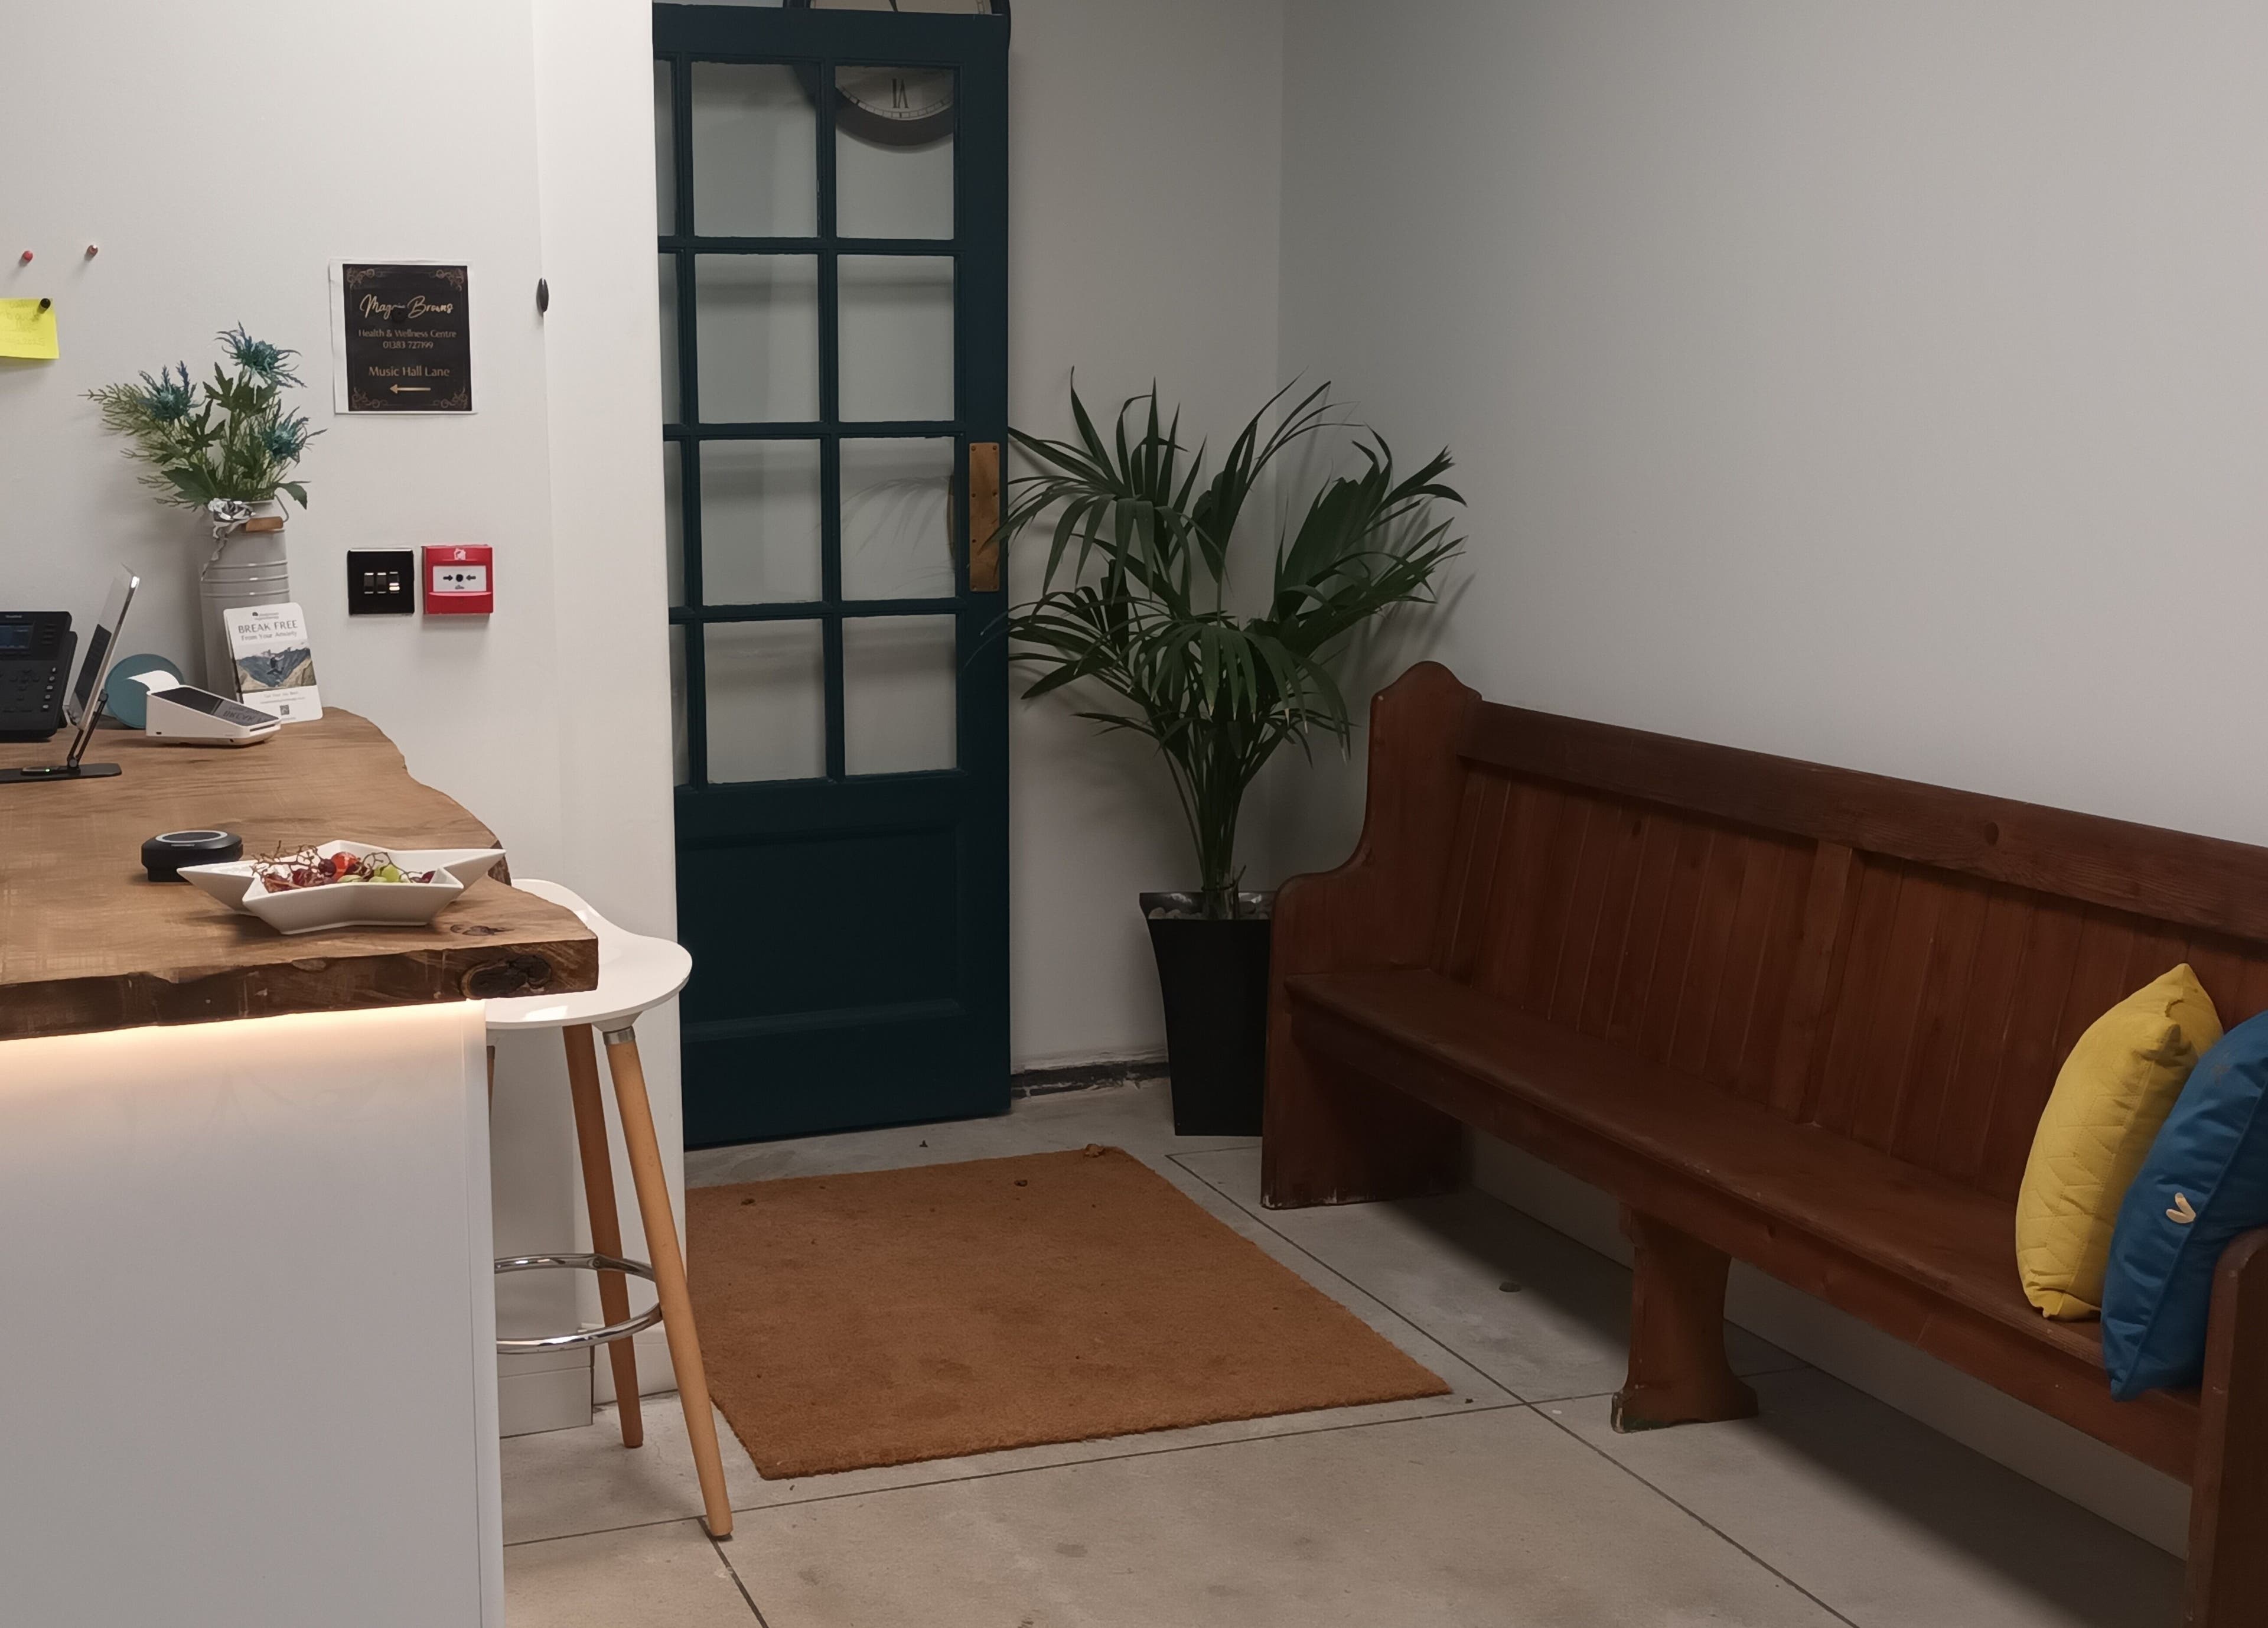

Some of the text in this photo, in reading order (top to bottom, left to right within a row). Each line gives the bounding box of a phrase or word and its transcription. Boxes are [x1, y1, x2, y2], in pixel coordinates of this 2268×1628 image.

[359, 328, 384, 337] Health
[395, 328, 428, 338] Wellness
[430, 330, 457, 338] Centre
[383, 341, 406, 349] 01383
[369, 366, 451, 376] Music Hall Lane
[238, 620, 298, 634] BREAK FREE
